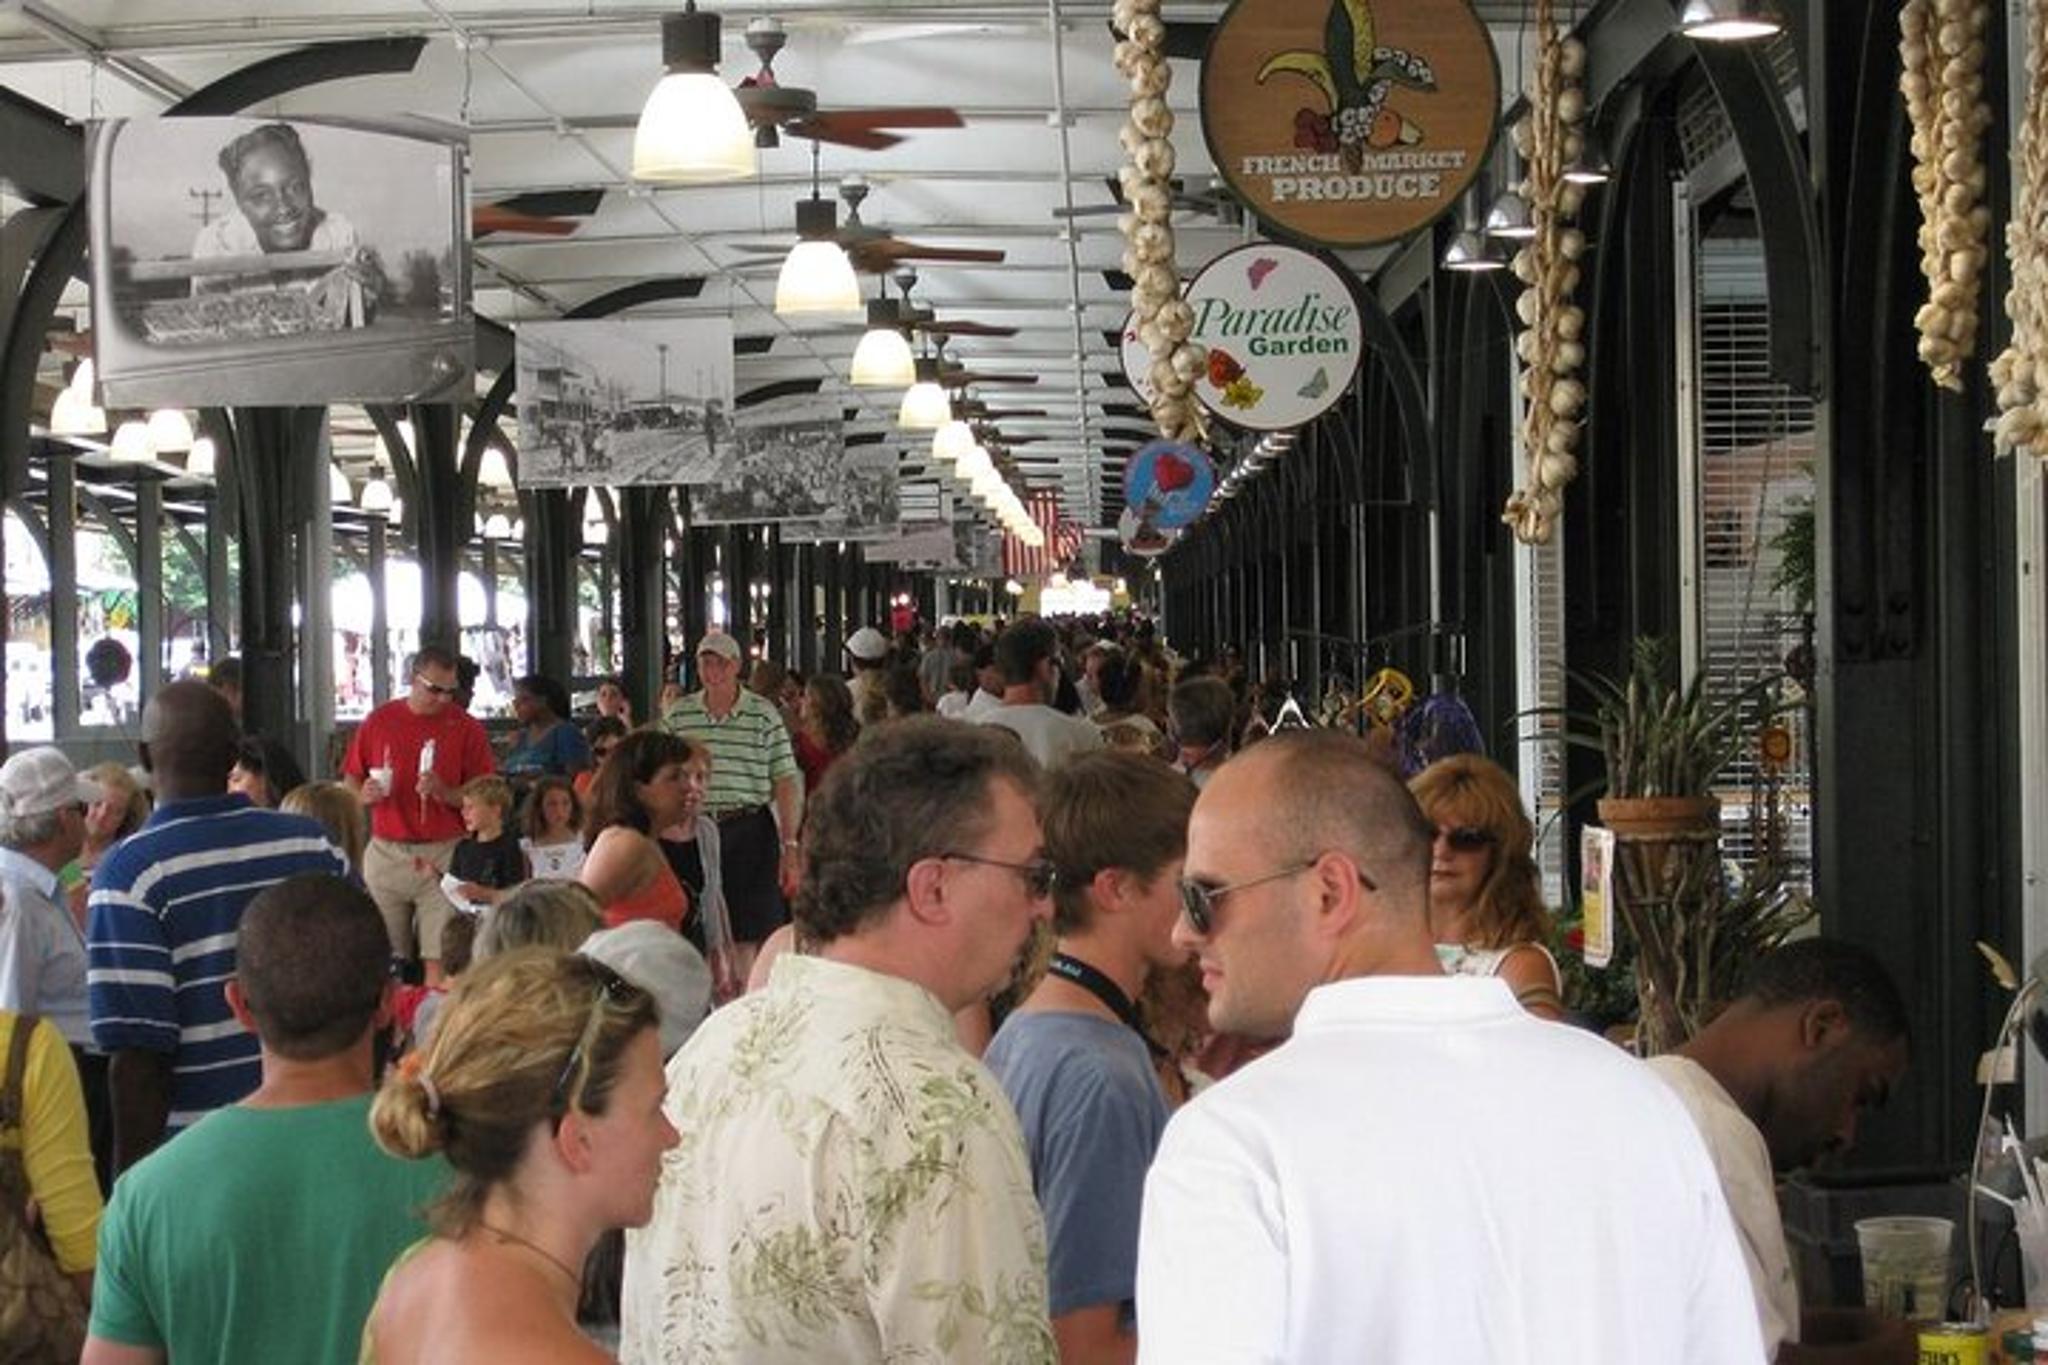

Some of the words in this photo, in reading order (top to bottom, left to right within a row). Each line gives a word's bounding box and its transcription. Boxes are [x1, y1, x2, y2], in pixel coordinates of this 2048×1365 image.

[1242, 154, 1341, 175] FRENCH
[1362, 150, 1466, 170] MARKET
[1271, 174, 1441, 201] PRODUCE
[1191, 292, 1351, 339] Paradise
[1249, 335, 1348, 357] Garden
